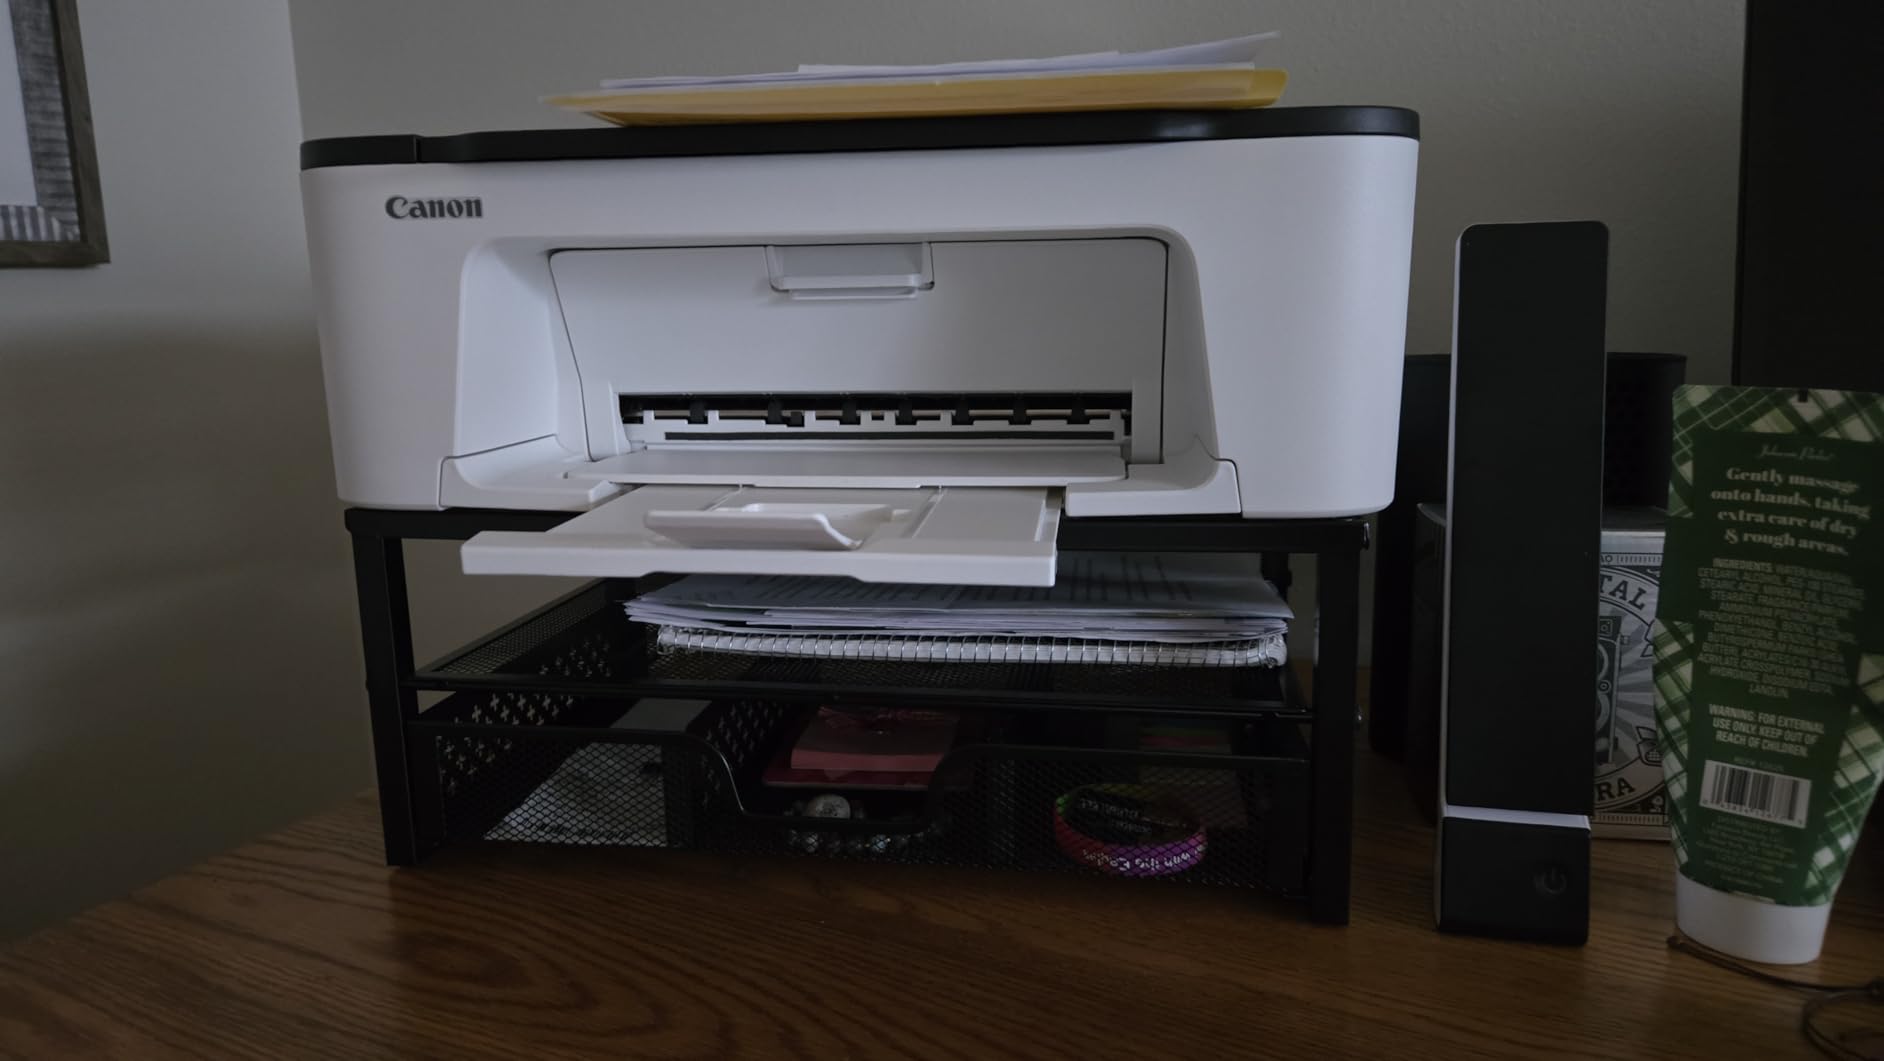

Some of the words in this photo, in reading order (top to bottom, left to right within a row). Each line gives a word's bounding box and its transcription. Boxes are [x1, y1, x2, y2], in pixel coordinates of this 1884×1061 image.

[385, 196, 482, 219] Canon
[1726, 467, 1784, 486] Gently
[1788, 474, 1859, 494] massage
[1711, 489, 1751, 501] onto
[1754, 488, 1811, 507] hands,
[1815, 497, 1872, 520] taking
[1717, 510, 1765, 522] extra
[1768, 514, 1808, 527] care
[1809, 517, 1829, 530] of
[1829, 520, 1856, 539] dry
[1724, 528, 1738, 544] &
[1743, 532, 1796, 548] rough
[1798, 539, 1848, 555] areas.
[1713, 716, 1731, 730] USE
[1759, 725, 1783, 739] KEEP
[1784, 729, 1803, 742] OUT
[1804, 733, 1819, 745] OF
[1758, 712, 1776, 725] FOR
[1777, 715, 1824, 735] EXTERNAL
[1716, 729, 1747, 745] REACH
[1748, 735, 1760, 748] OF
